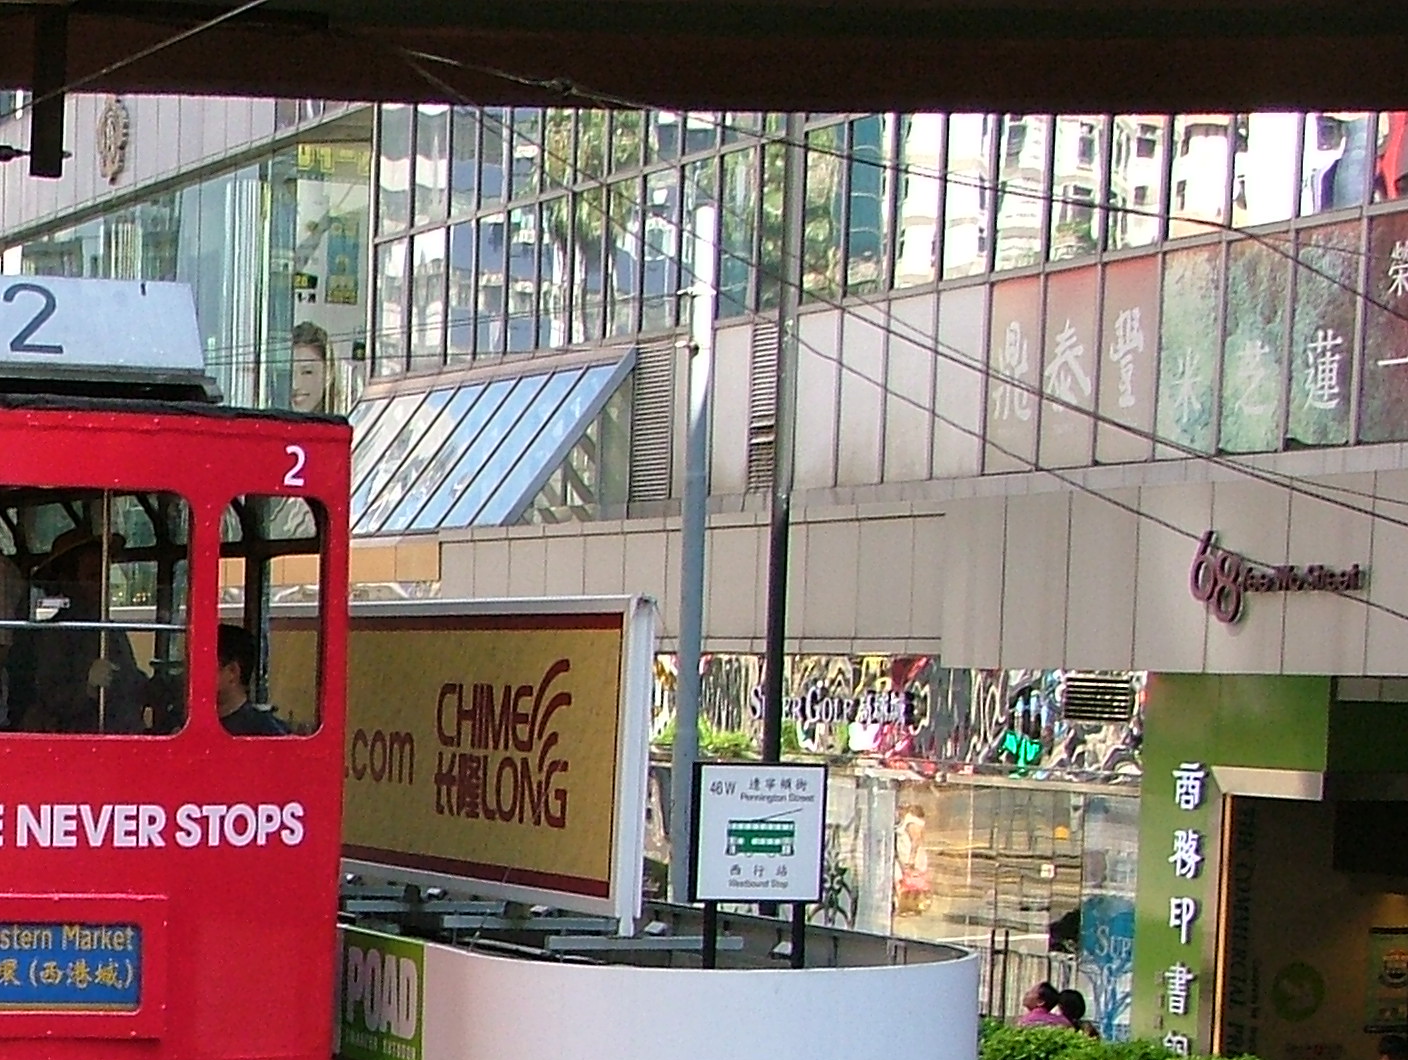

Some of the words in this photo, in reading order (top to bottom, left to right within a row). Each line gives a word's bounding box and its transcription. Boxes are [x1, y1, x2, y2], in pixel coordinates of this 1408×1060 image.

[2, 283, 64, 355] 2
[1171, 328, 1344, 424] 米芝蓮
[283, 445, 307, 487] 2
[1190, 530, 1243, 624] 68
[436, 682, 537, 753] CHIME
[16, 804, 166, 847] NEVER
[175, 803, 304, 847] STOPS
[481, 754, 570, 829] LONG
[62, 925, 134, 951] Market
[346, 946, 417, 1040] POAD
